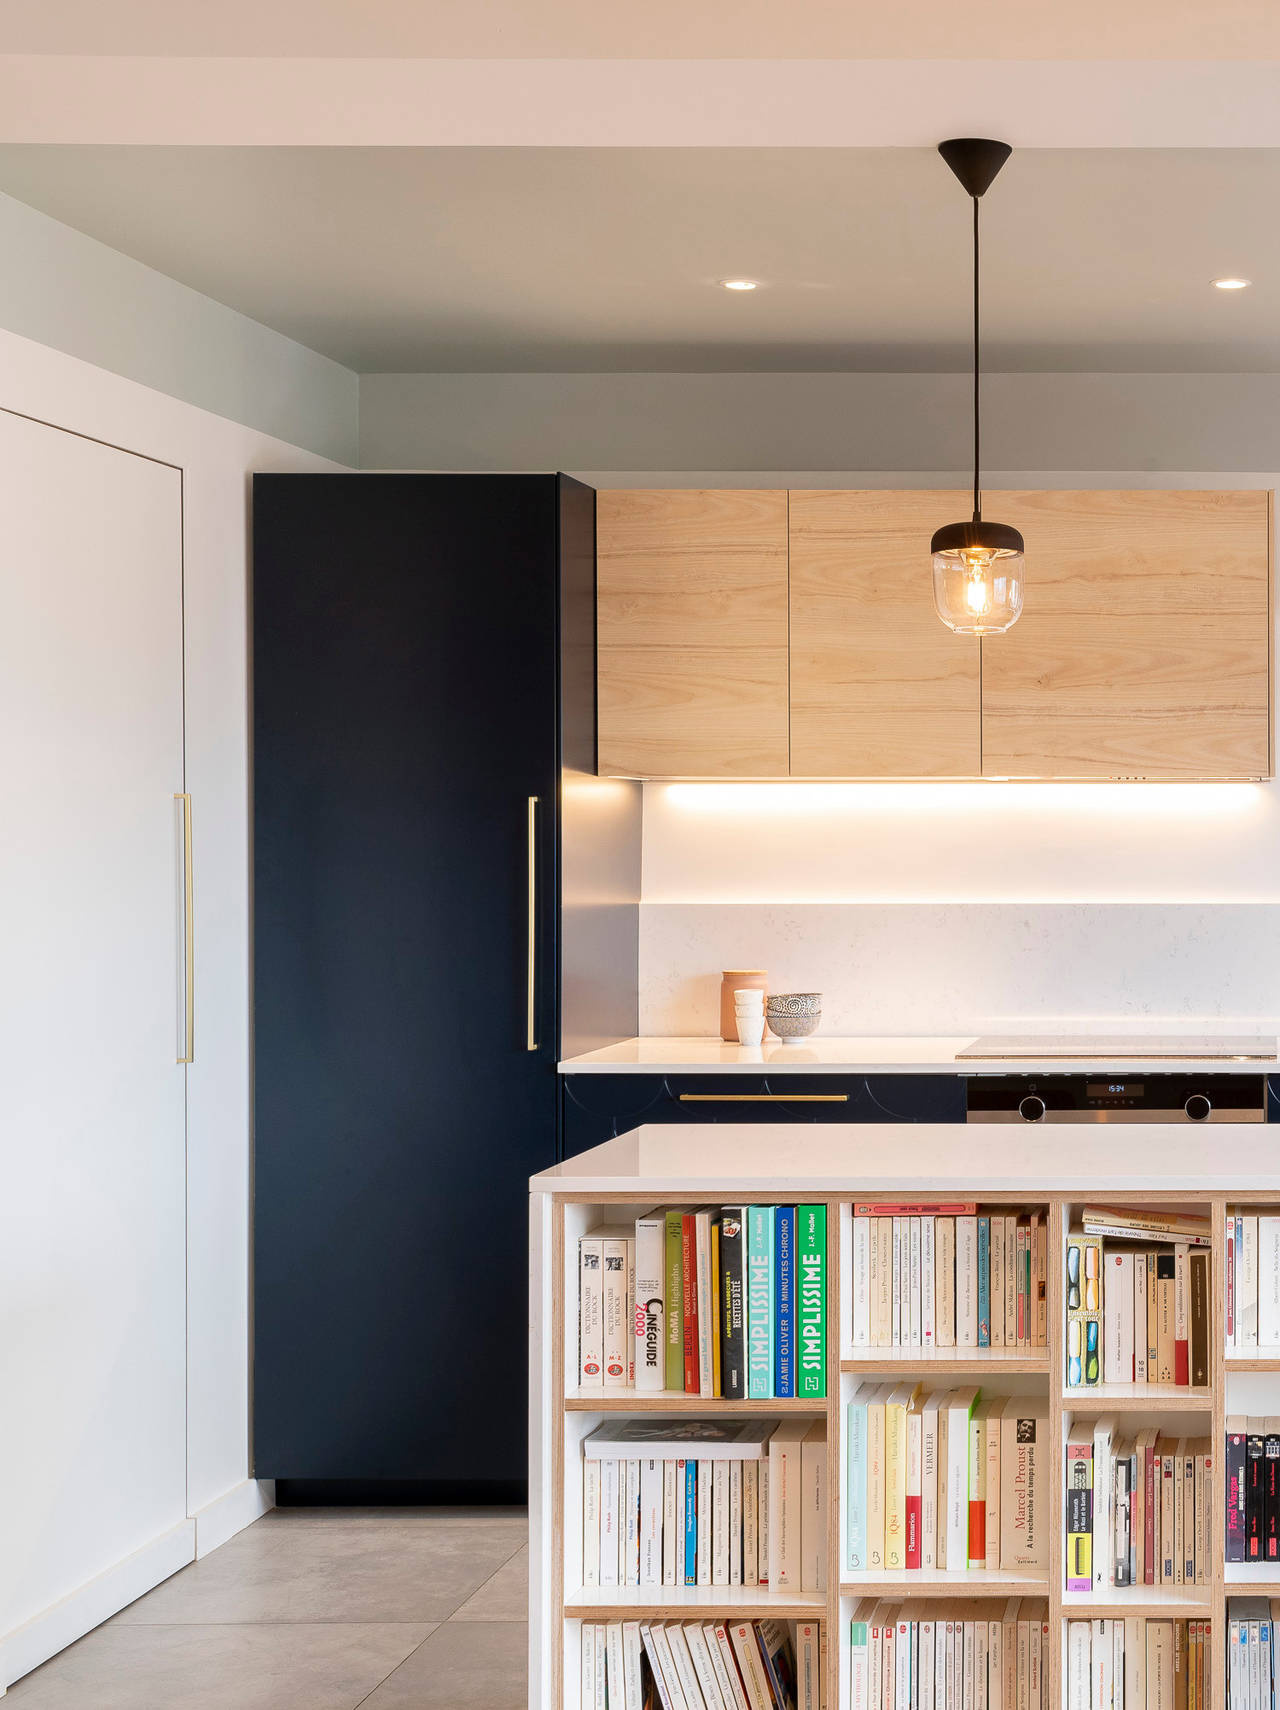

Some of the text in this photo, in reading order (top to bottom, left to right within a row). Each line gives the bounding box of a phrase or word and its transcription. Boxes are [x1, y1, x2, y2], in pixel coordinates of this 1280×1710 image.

[731, 1280, 741, 1328] RECETTES D'ÉTÉ
[751, 1255, 768, 1371] SIMPLISSIME
[781, 1219, 789, 1386] JAMIE OLIVER 30 MINUTES CHRONO
[803, 1254, 821, 1369] SIMPLISSIME
[592, 1317, 597, 1325] DU
[615, 1317, 620, 1326] DU
[635, 1304, 647, 1336] 2000
[670, 1311, 679, 1344] MoMA
[684, 1326, 692, 1356] BERLIN
[1027, 1447, 1035, 1466] perdu
[1015, 1446, 1025, 1529] Marcel Proust
[1027, 1489, 1033, 1498] du
[1229, 1476, 1238, 1505] Vargas
